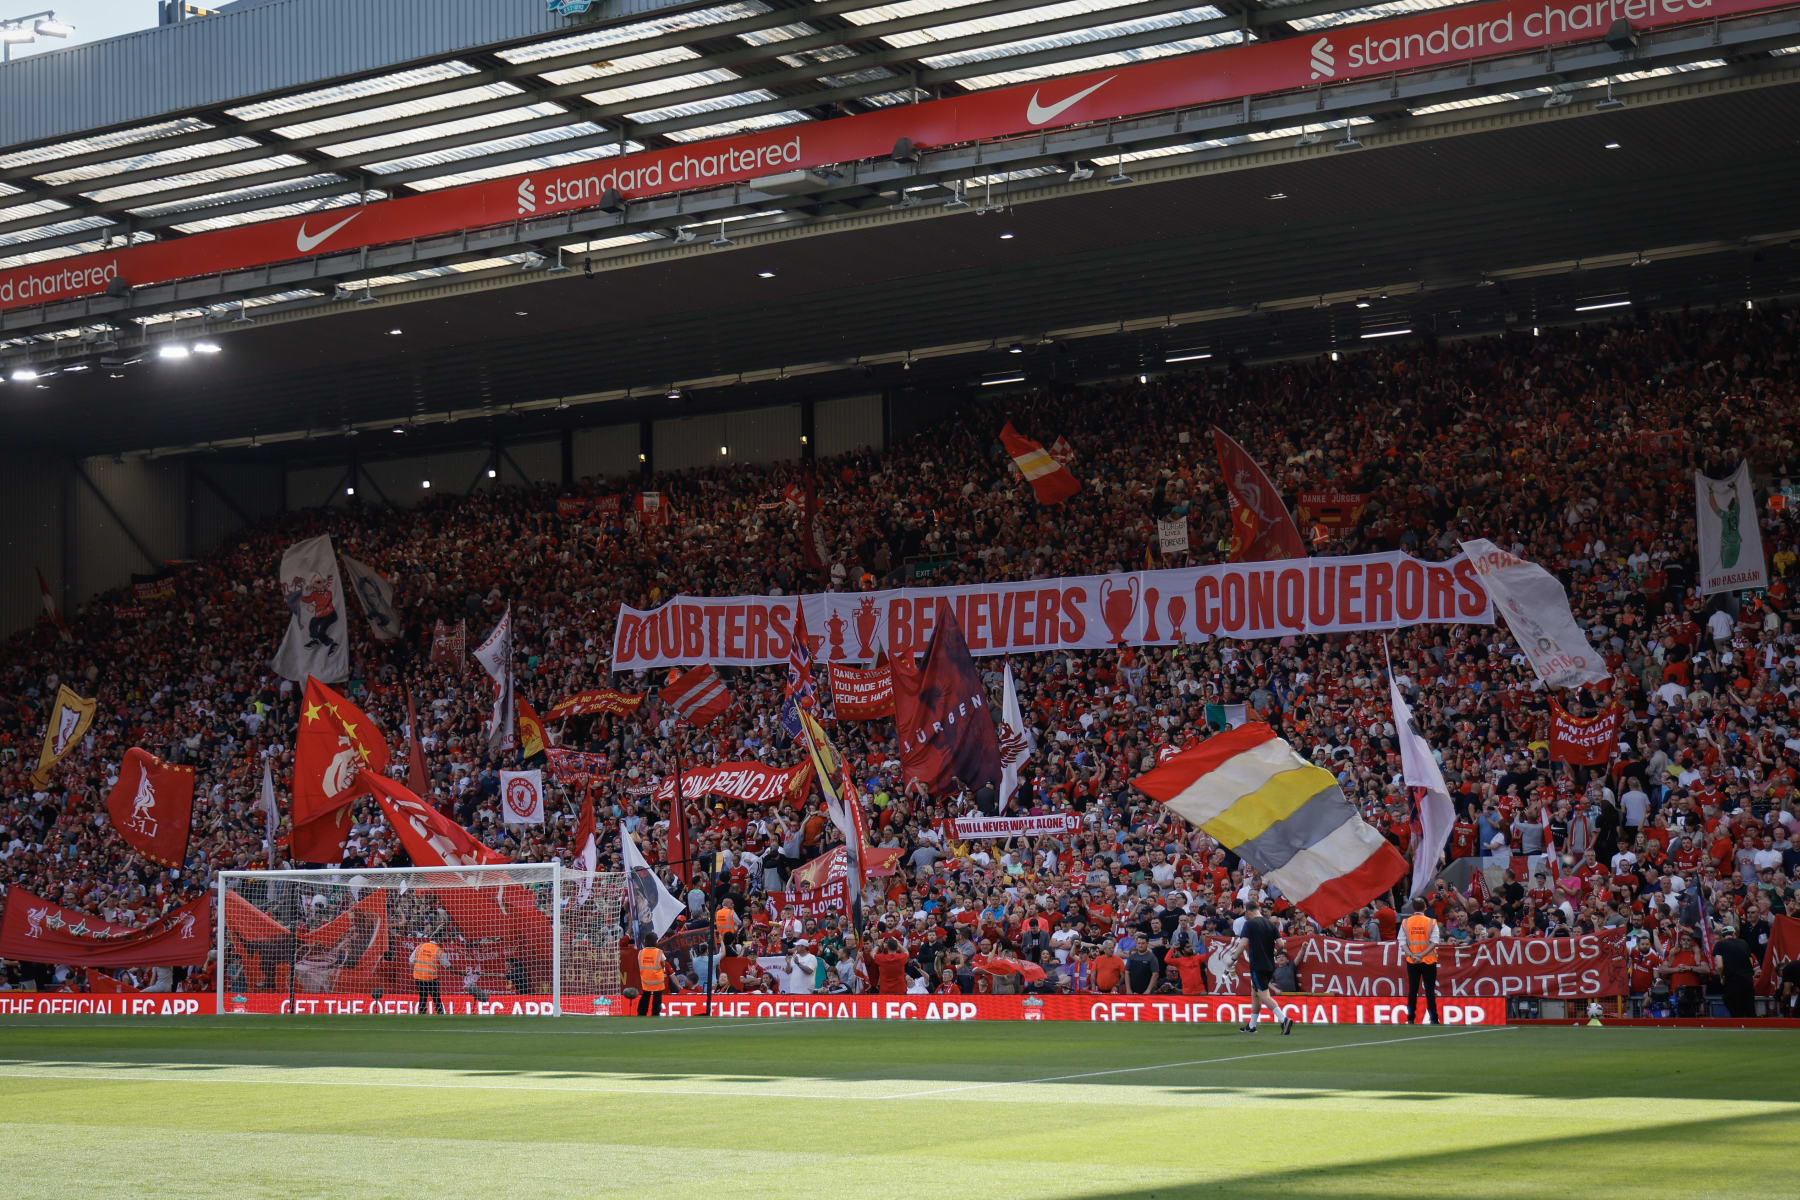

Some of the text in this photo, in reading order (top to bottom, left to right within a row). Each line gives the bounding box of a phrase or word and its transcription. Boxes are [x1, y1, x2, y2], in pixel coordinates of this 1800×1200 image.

[1346, 0, 1712, 69] standard chartere
[544, 135, 800, 204] standard chartered
[18, 259, 118, 298] chartered
[915, 570, 931, 578] EXIT
[616, 604, 792, 663] DOUBTERS
[1195, 558, 1487, 635] CONQUERORS
[833, 667, 861, 680] DANKE
[835, 676, 892, 693] YOU MADE THE
[835, 693, 868, 704] PEOPLE
[983, 820, 1009, 832] NEVER
[1036, 817, 1064, 829] ALONE
[1066, 815, 1081, 829] 97
[821, 882, 843, 898] LIFE
[1302, 937, 1365, 967] ARE
[1454, 935, 1600, 968] FAMOUS
[1450, 969, 1600, 996] KOPITES
[0, 999, 199, 1014] THE OFFICIAL LFC APP
[324, 1000, 363, 1014] THE
[512, 1001, 554, 1015] APP
[757, 1002, 856, 1017] OFFICIAL
[872, 1002, 917, 1018] LFC
[925, 1002, 977, 1019] APP
[1090, 1002, 1145, 1022] GET
[1152, 1003, 1208, 1022] THE
[1356, 1004, 1409, 1024] LFC
